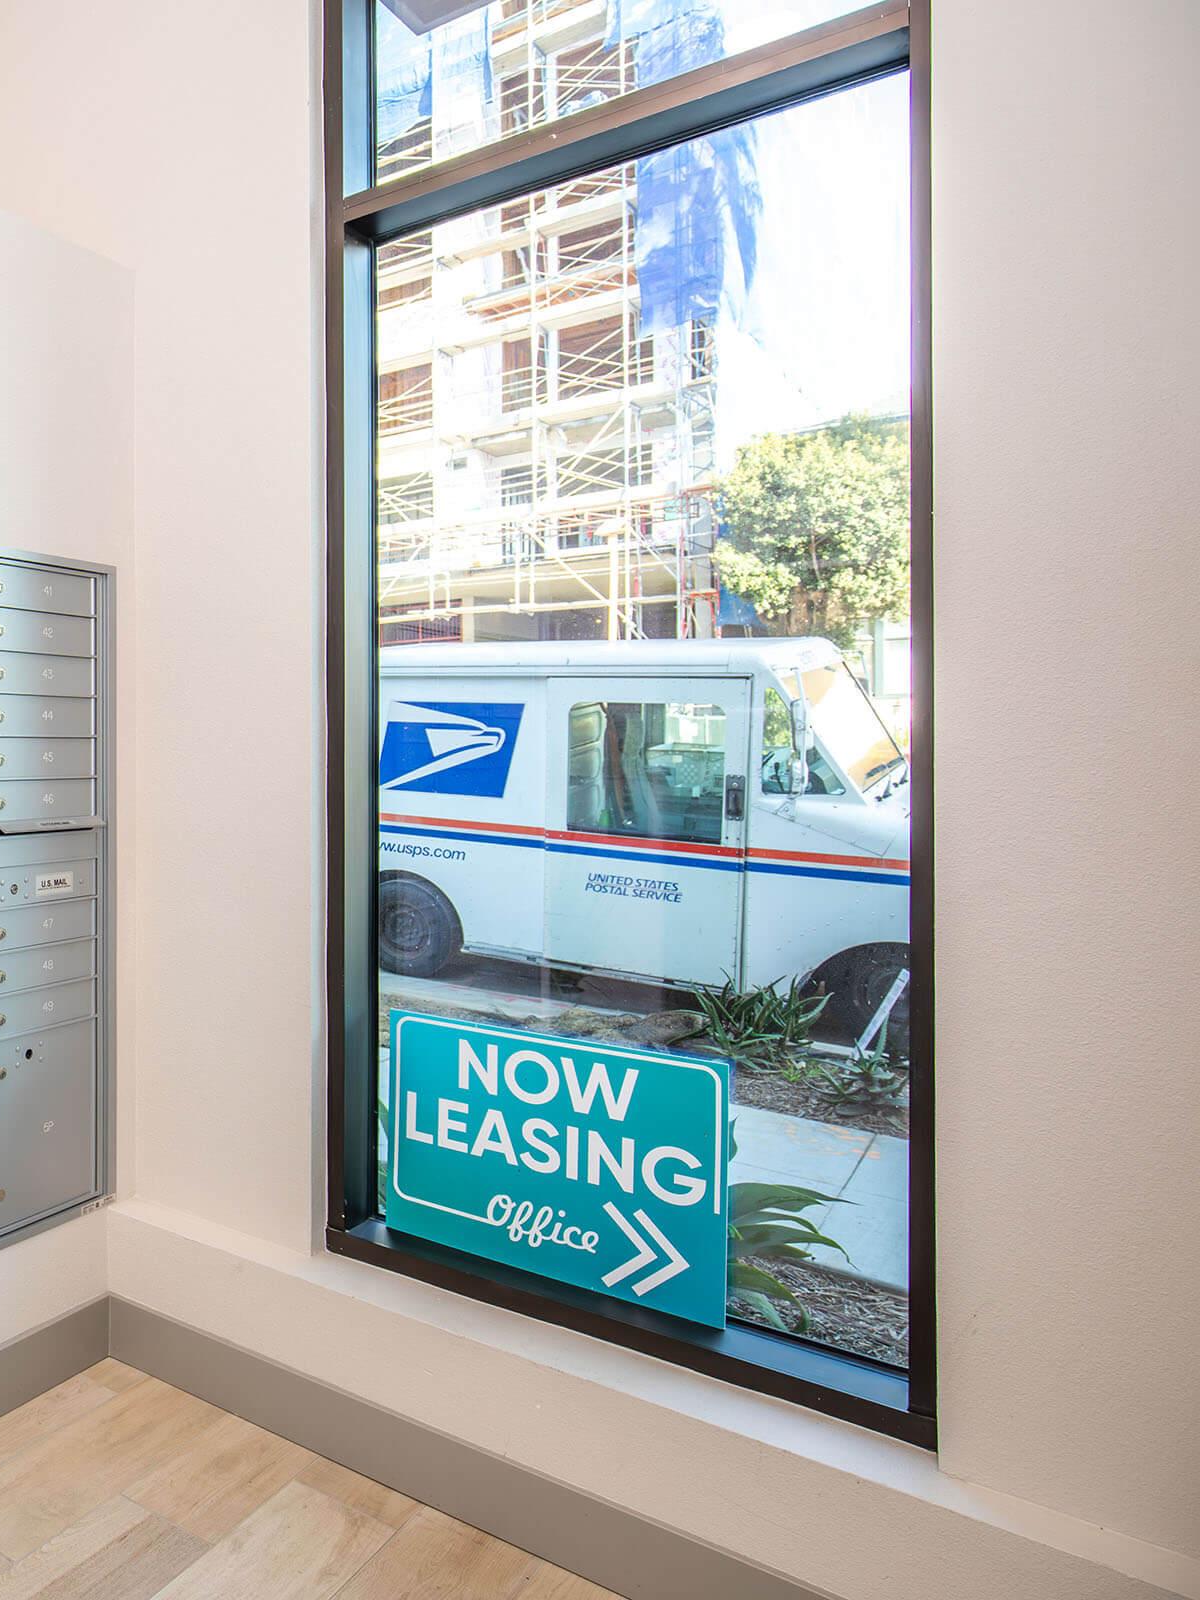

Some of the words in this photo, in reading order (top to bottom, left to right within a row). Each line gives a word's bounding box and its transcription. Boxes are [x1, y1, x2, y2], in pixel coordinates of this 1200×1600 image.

[43, 585, 54, 597] 41
[43, 627, 53, 638] 42
[42, 669, 54, 679] 43
[42, 711, 53, 720] 44
[43, 752, 53, 762] 45
[43, 794, 54, 804] 46
[379, 841, 466, 861] w.usps.com
[41, 879, 53, 888] U.S.
[53, 878, 68, 886] MAIL
[587, 872, 633, 886] UNITED
[634, 878, 679, 892] STATES
[584, 882, 629, 897] POSTAL
[632, 888, 683, 903] SERVICE
[43, 918, 53, 928] 47
[43, 960, 53, 969] 48
[43, 1001, 54, 1012] 49
[458, 1038, 640, 1122] NOW
[406, 1090, 707, 1207] LEASING
[486, 1194, 600, 1254] Office
